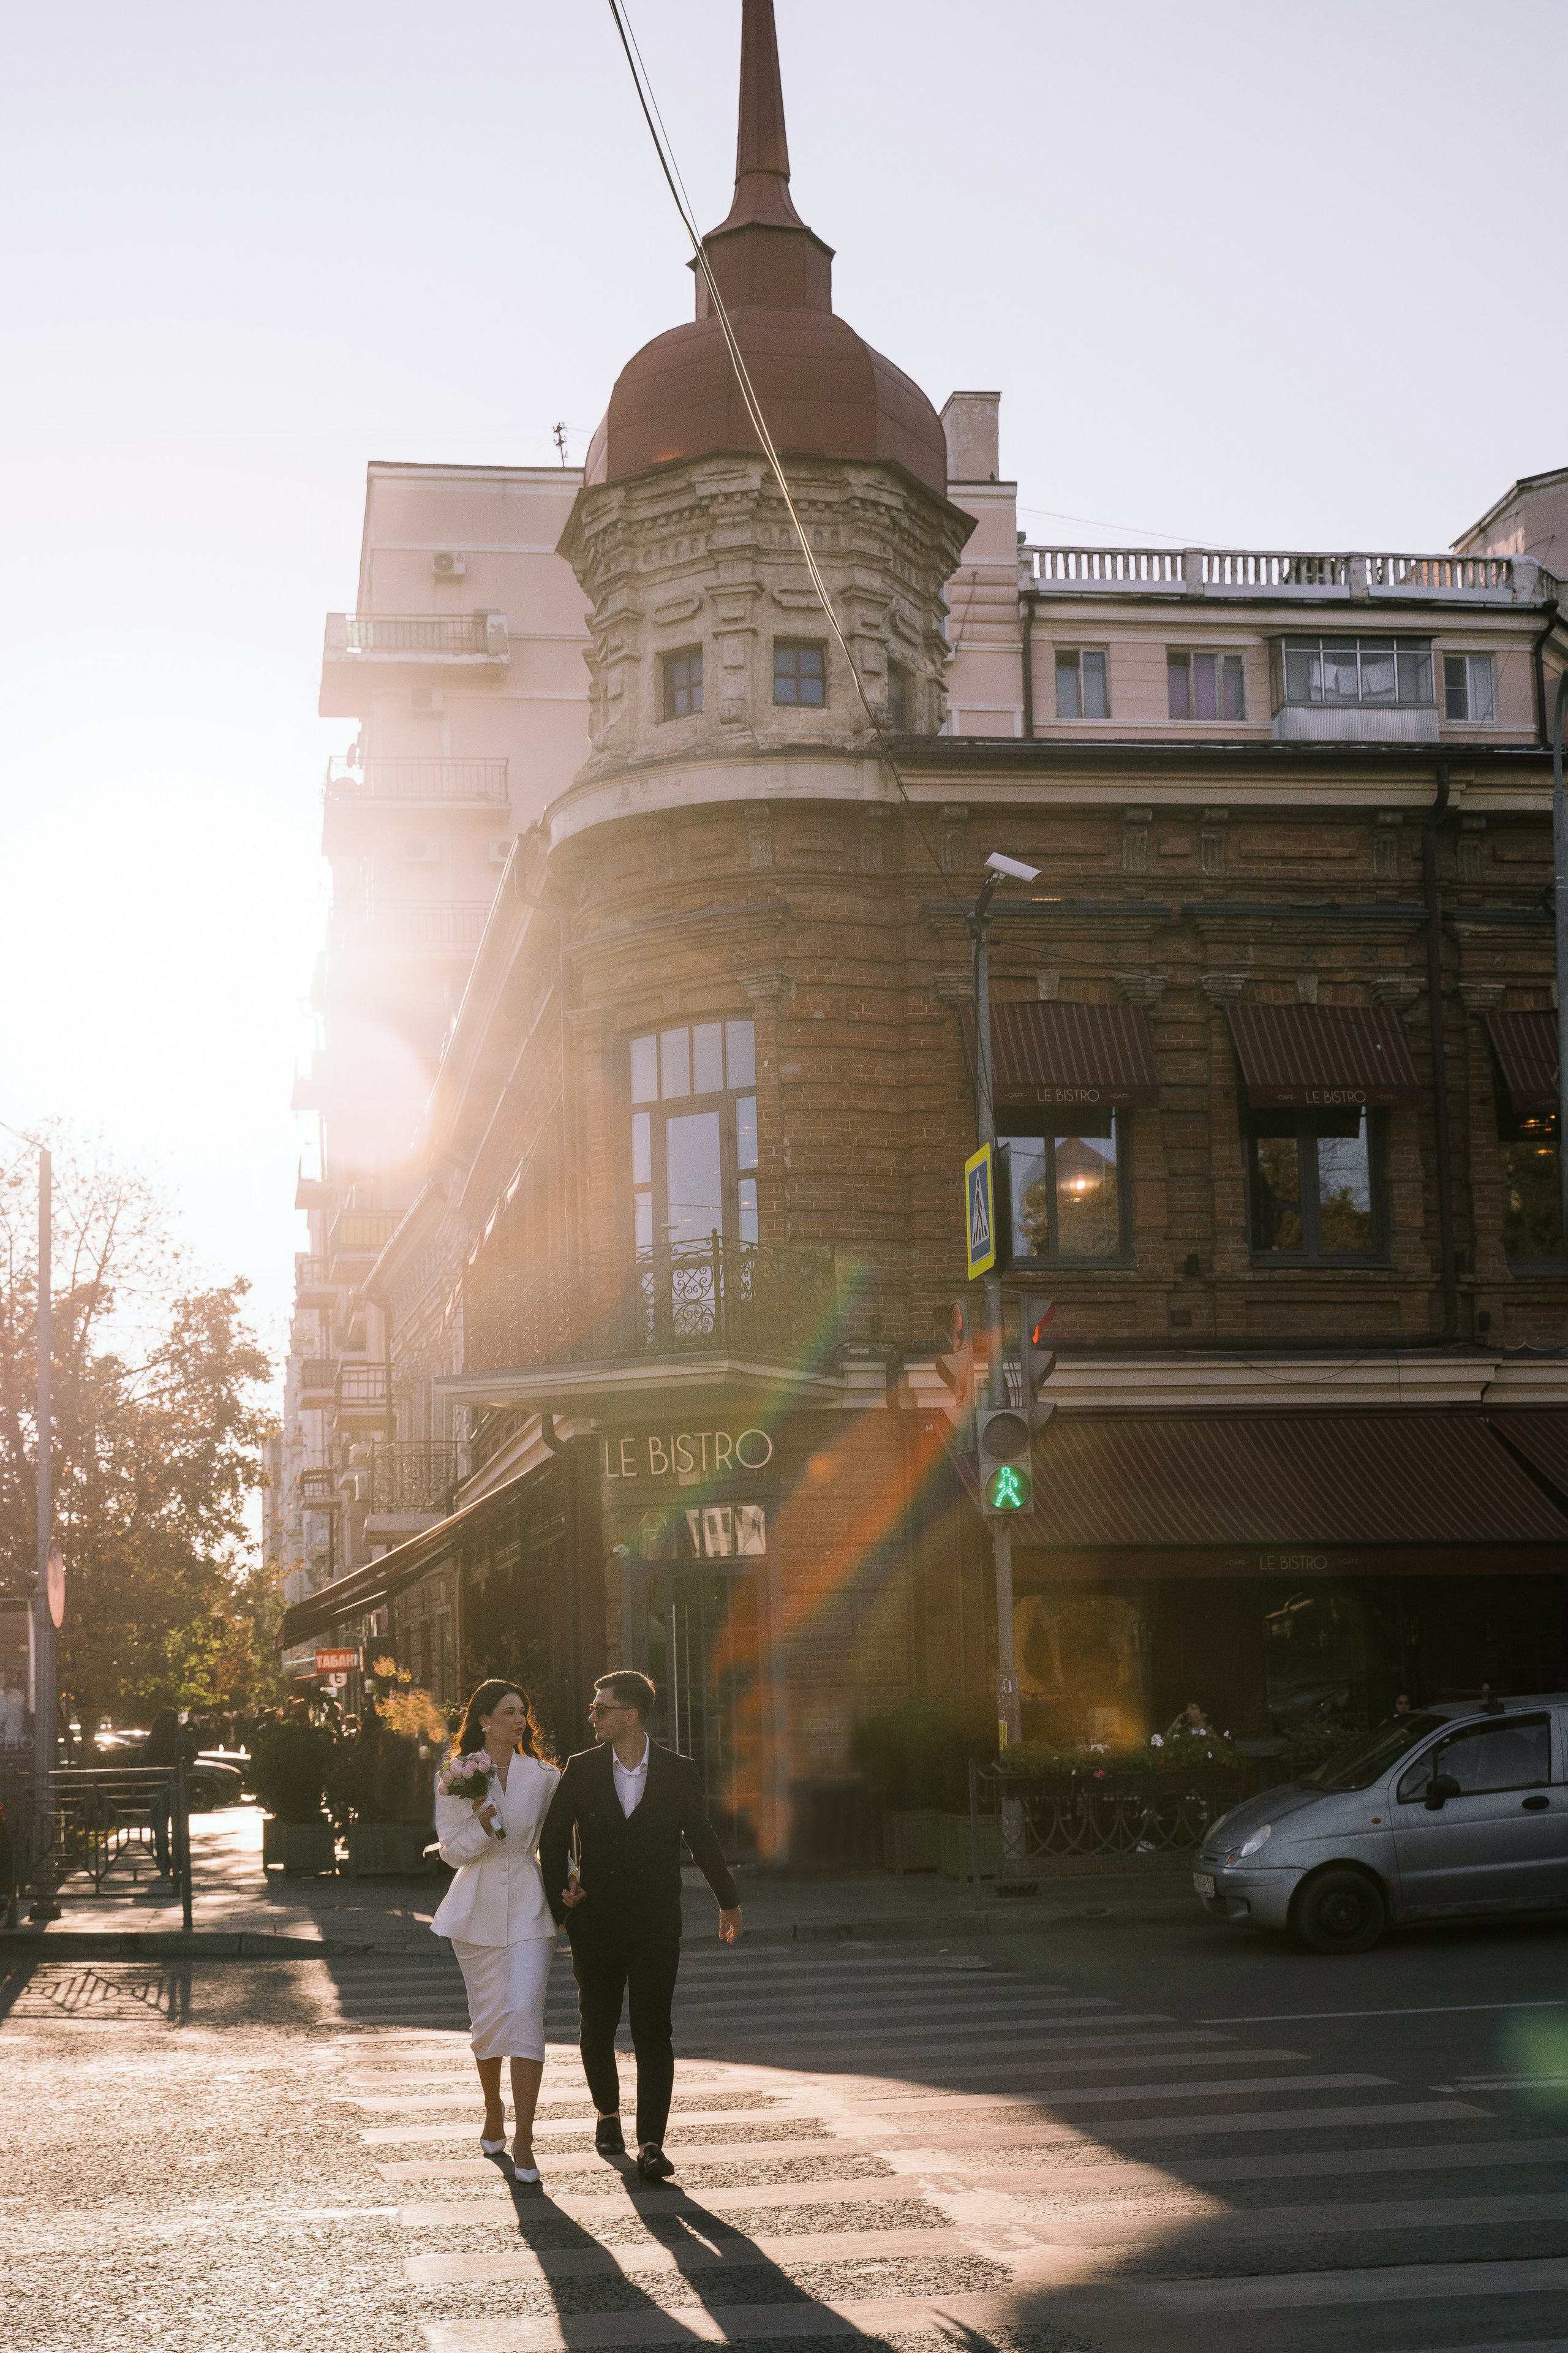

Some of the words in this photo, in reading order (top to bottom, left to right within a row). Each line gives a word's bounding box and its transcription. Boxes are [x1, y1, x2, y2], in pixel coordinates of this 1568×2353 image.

[1037, 1089, 1052, 1102] LE
[1056, 1089, 1100, 1102] BISTRO
[1305, 1090, 1320, 1104] LE
[1324, 1090, 1366, 1104] BISTRO
[605, 1438, 637, 1478] LE
[649, 1429, 772, 1475] BISTRO
[1259, 1556, 1276, 1570] LE
[1279, 1555, 1328, 1570] BISTRO
